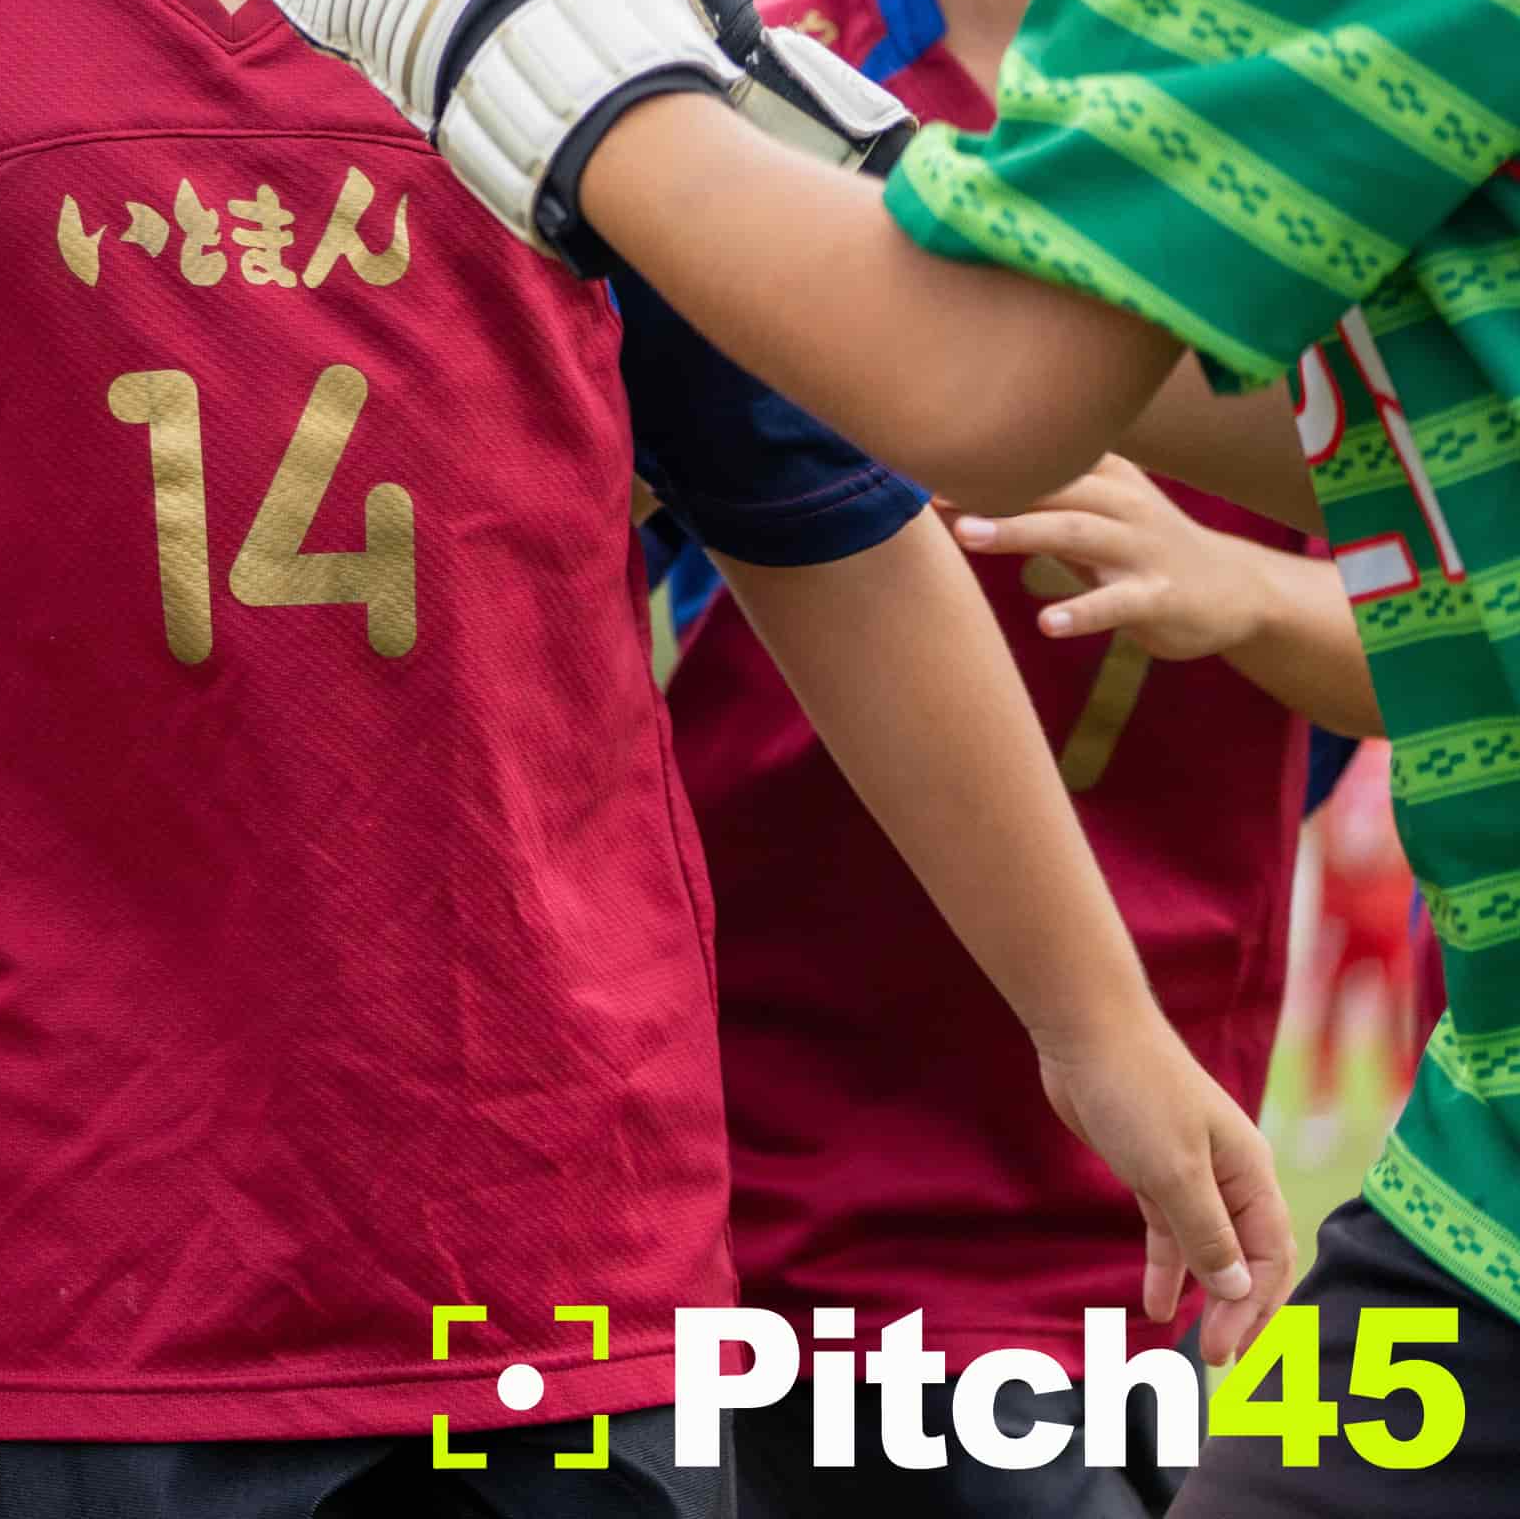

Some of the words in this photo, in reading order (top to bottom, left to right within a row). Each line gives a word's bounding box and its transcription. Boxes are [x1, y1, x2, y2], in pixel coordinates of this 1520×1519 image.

[57, 166, 411, 289] いとまん
[108, 364, 417, 665] 14
